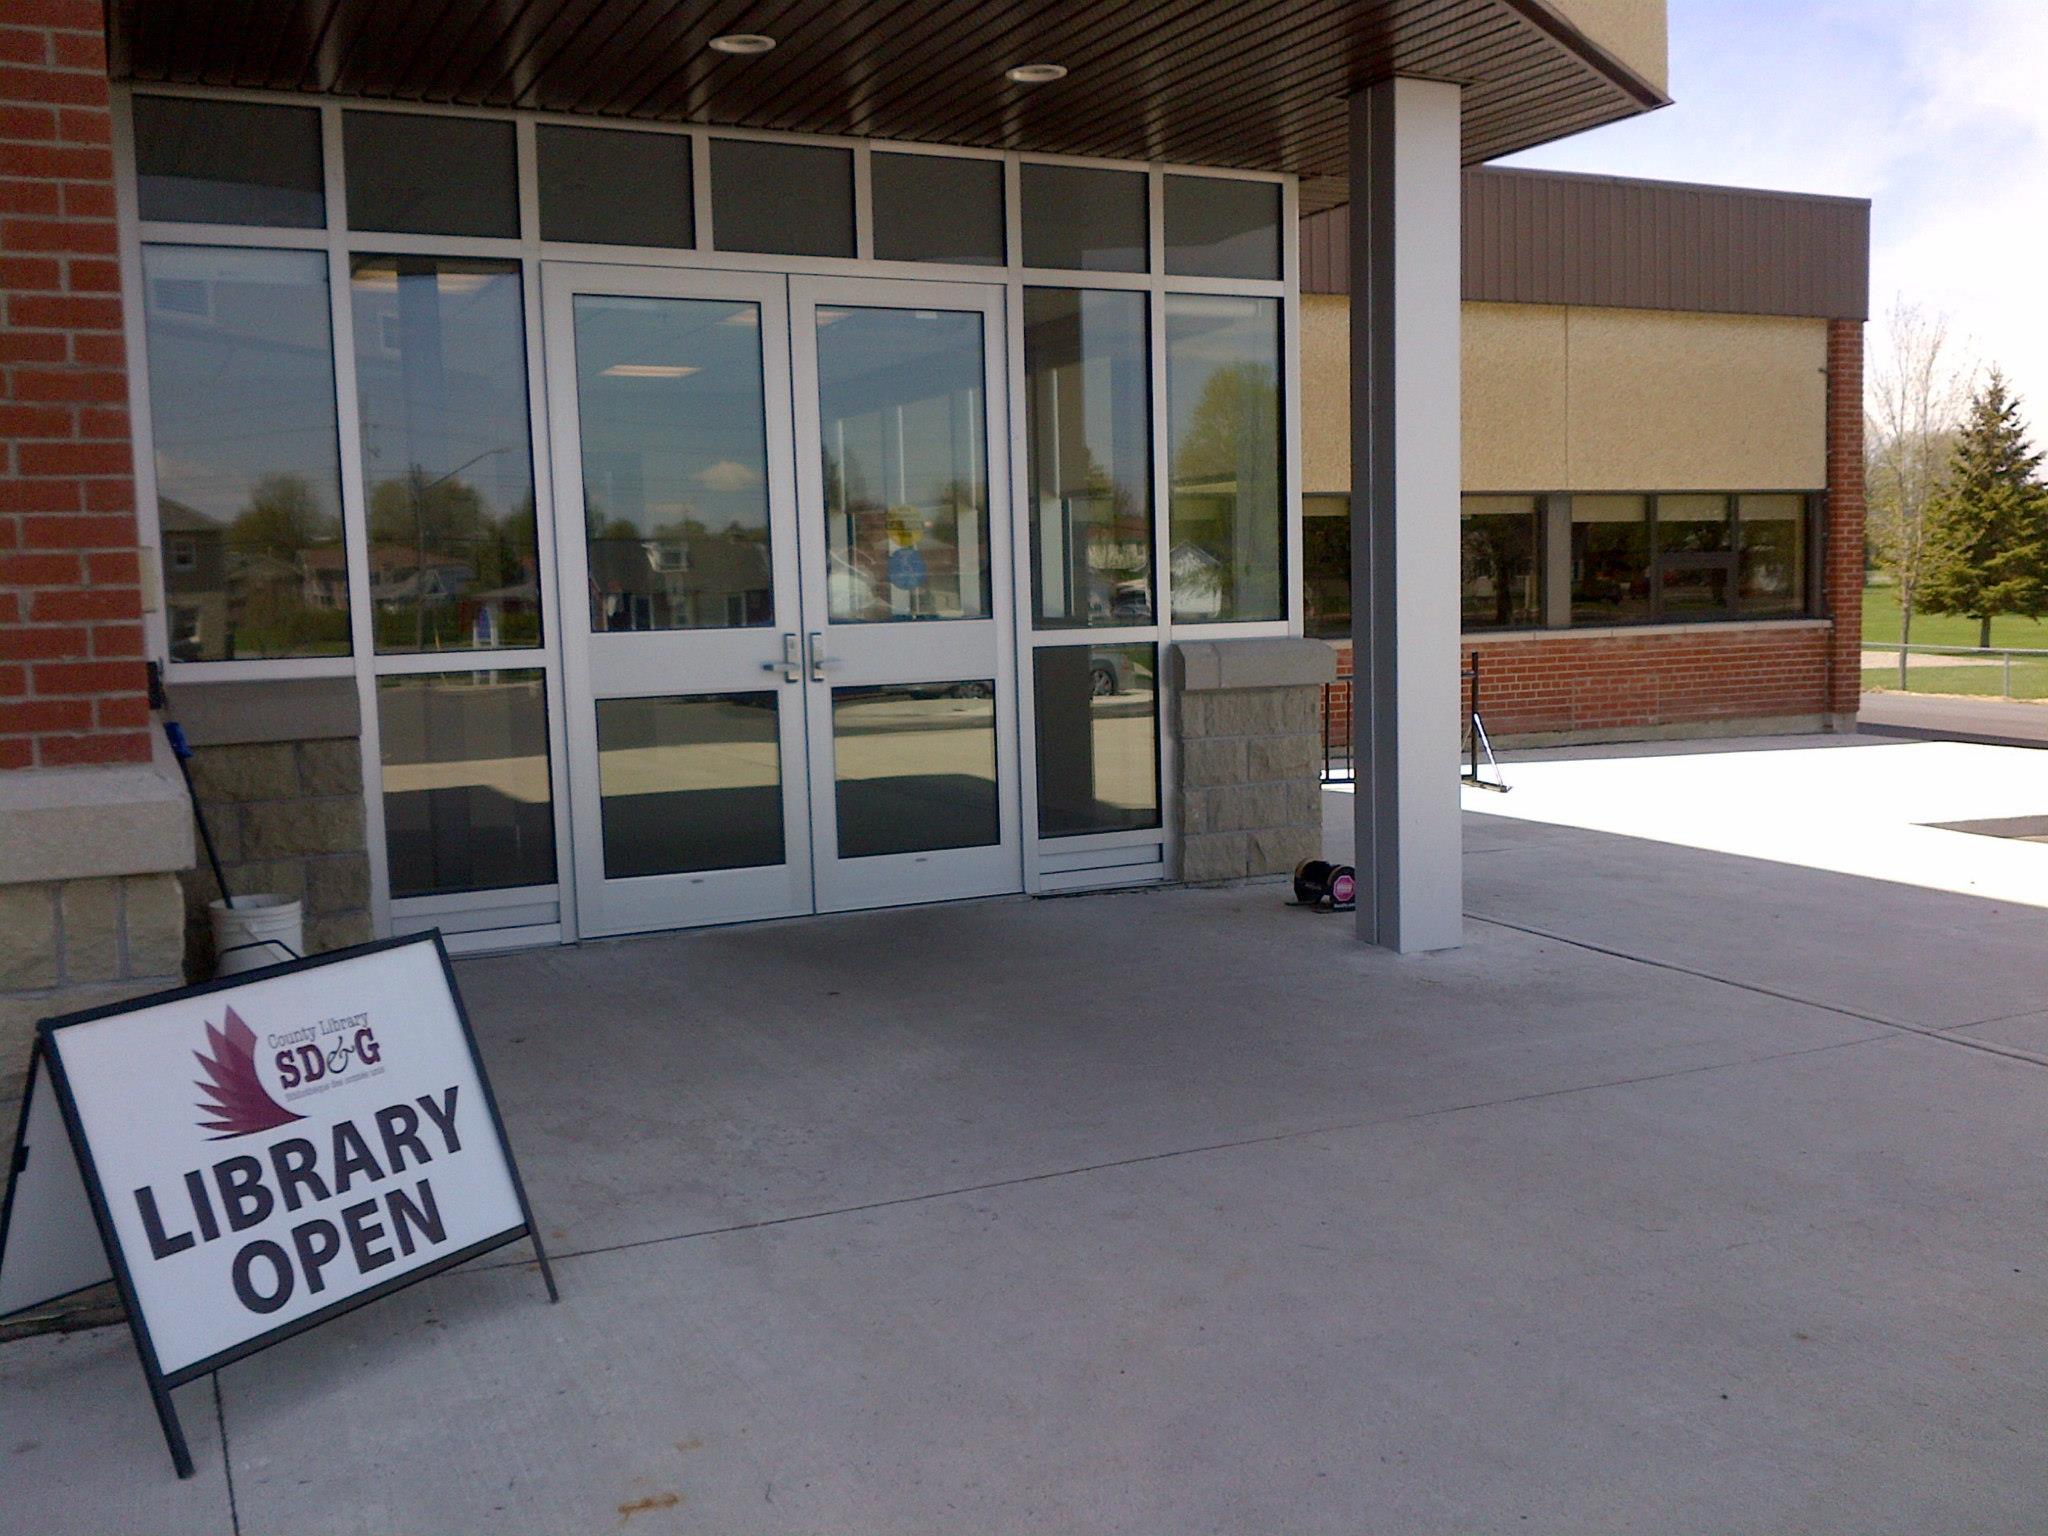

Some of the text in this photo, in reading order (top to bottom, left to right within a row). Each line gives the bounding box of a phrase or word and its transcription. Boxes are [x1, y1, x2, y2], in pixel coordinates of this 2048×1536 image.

[267, 1012, 368, 1049] County Library
[134, 1086, 462, 1261] LIBRARY
[232, 1179, 447, 1315] OPEN
